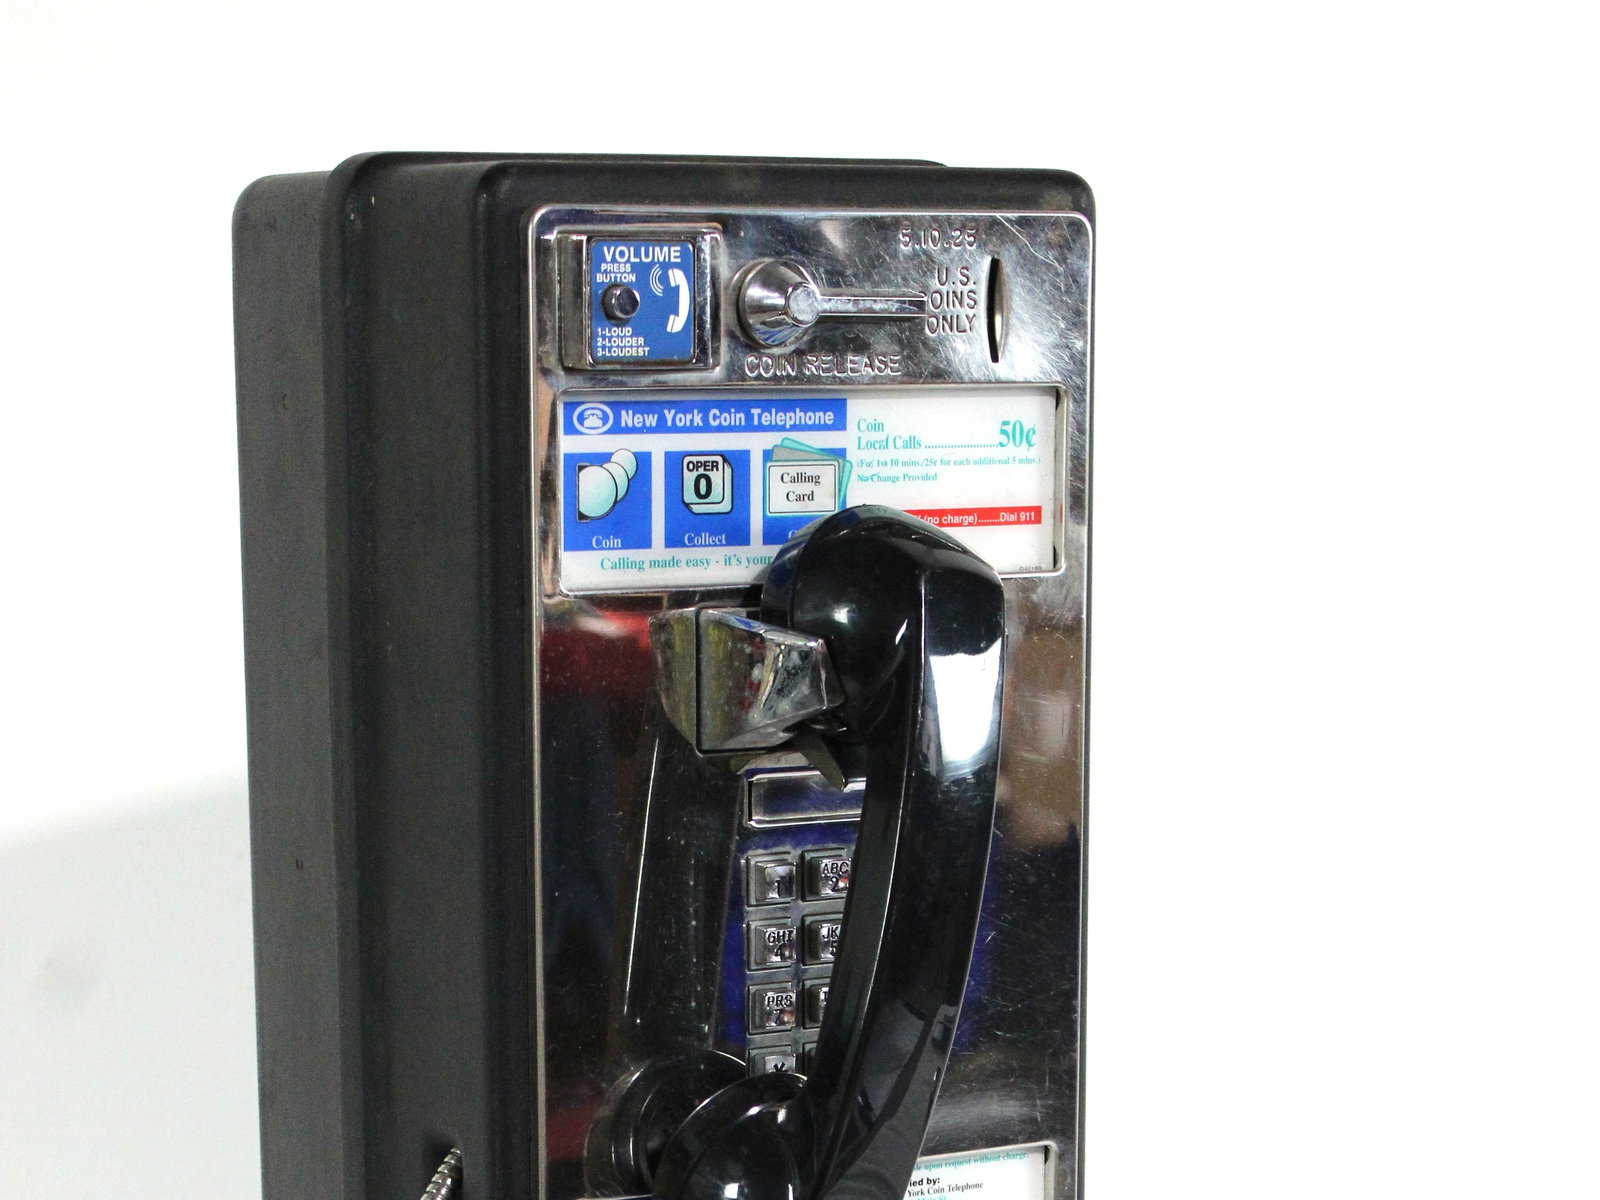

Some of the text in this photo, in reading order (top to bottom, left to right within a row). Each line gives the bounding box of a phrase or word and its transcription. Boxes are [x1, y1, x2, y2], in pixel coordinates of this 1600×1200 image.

[603, 246, 681, 262] VOLUME
[601, 263, 631, 272] PRESS
[596, 274, 636, 283] BUTTON
[936, 267, 976, 290] U.S.
[918, 289, 977, 312] OINS
[926, 314, 977, 336] ONLY
[597, 328, 632, 337] 1-LOUD
[597, 337, 644, 347] 2-LOUDER
[597, 347, 650, 356] 3-LOUDEST
[744, 352, 902, 378] COIN RELEASE
[621, 408, 834, 430] New York Coin Telephone
[857, 418, 884, 433] Coin
[893, 435, 922, 450] Calls
[998, 420, 1036, 451] 50¢
[686, 460, 719, 474] OPER
[954, 458, 970, 467] each
[973, 456, 1010, 467] additional
[780, 472, 820, 487] Calling
[902, 474, 938, 483] Provided
[693, 474, 712, 500] 0
[786, 490, 814, 502] Card
[942, 513, 978, 527] charge)
[1000, 512, 1017, 522] Dial
[1020, 512, 1035, 522] 911
[592, 536, 622, 549] Coin
[684, 532, 726, 546] Collect
[600, 556, 645, 573] Calling
[648, 556, 683, 570] made
[686, 558, 711, 571] easy
[746, 555, 773, 568] your
[822, 862, 849, 876] ABC
[768, 930, 793, 944] GHI
[767, 994, 793, 1008] PRS
[945, 1154, 1000, 1169] request without
[926, 1177, 940, 1188] by:
[908, 1182, 984, 1198] York Coin Telephone
